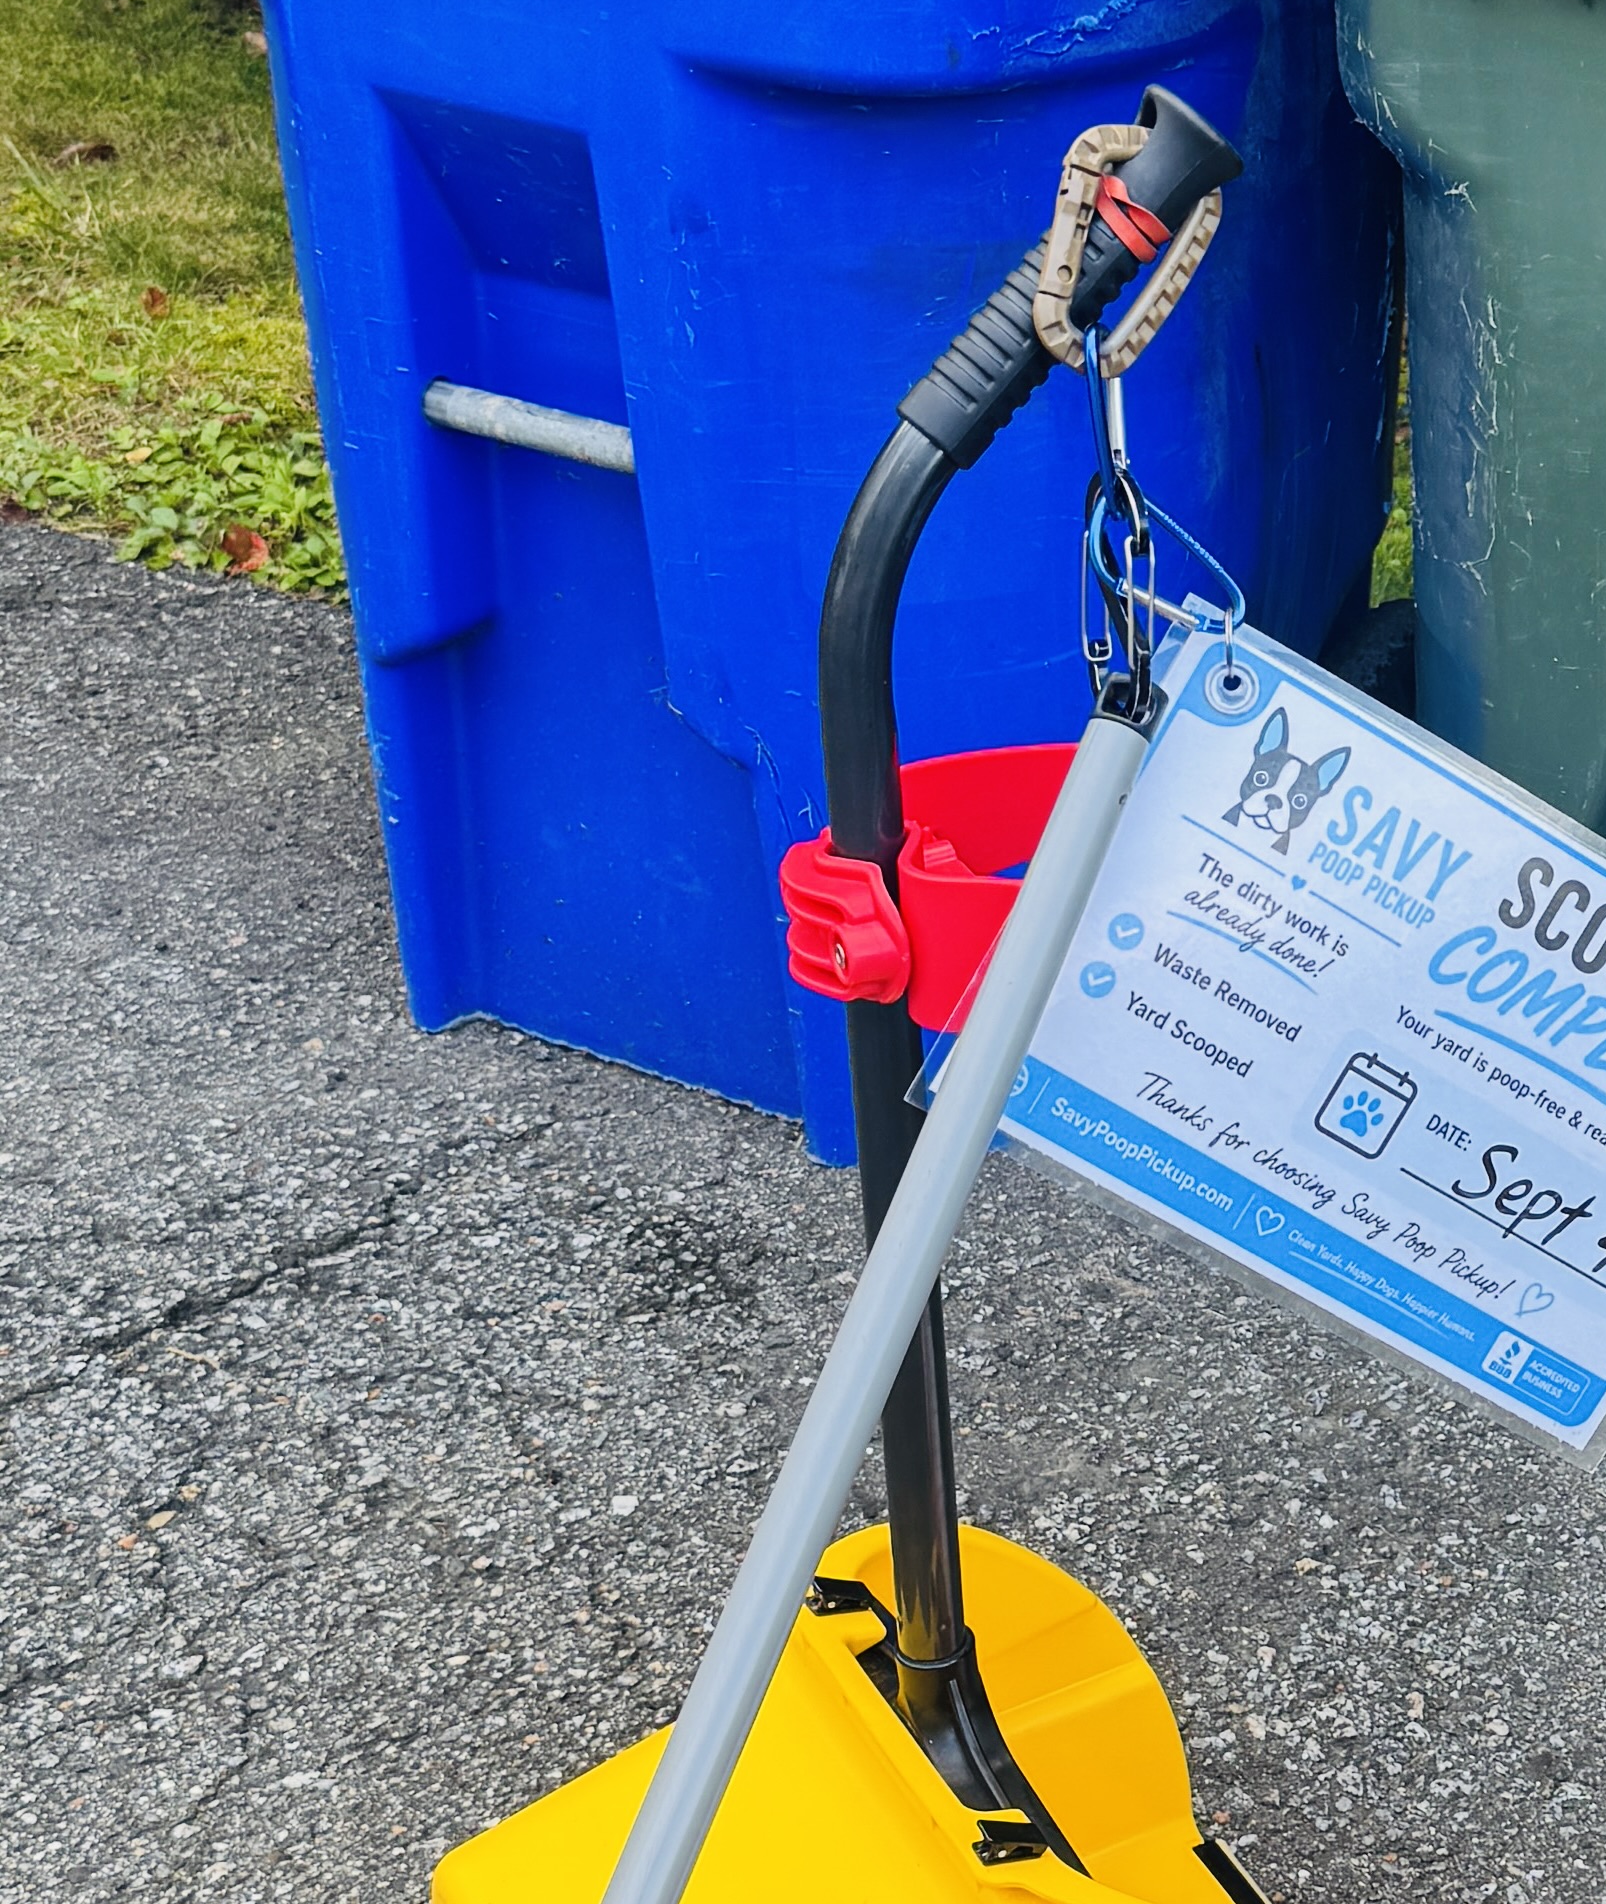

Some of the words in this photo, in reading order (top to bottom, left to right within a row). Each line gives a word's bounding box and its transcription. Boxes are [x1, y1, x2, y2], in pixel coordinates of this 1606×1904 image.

[1308, 841, 1365, 886] POOP
[1362, 874, 1436, 929] PICKUP
[1327, 786, 1473, 902] SAVY
[1184, 889, 1265, 952] already
[1268, 937, 1336, 978] done!
[1198, 853, 1234, 888] The
[1237, 881, 1283, 918] dirty
[1285, 910, 1331, 946] work
[1332, 934, 1350, 957] is
[1126, 990, 1171, 1030] Yard
[1170, 1019, 1254, 1078] Scooped
[1153, 943, 1212, 990] Waste
[1214, 980, 1303, 1042] Removed
[1396, 1005, 1434, 1041] Your
[1431, 1033, 1474, 1063] yard
[1472, 1052, 1489, 1073] is
[1488, 1066, 1567, 1120] poop-free
[1568, 1111, 1583, 1130] &
[1050, 1096, 1234, 1212] SavyPoopPickup.com
[1426, 1114, 1472, 1152] DATE:
[1136, 1071, 1214, 1132] Thanks
[1208, 1121, 1250, 1147] for
[1252, 1148, 1337, 1210] choosing
[1341, 1192, 1393, 1240] Savy
[1392, 1222, 1437, 1262] Poop
[1438, 1247, 1517, 1300] Pickup!
[1451, 1144, 1597, 1246] Sept
[1287, 1228, 1316, 1253] Clean
[1345, 1261, 1376, 1287] Happy
[1521, 1371, 1564, 1400] BUSINESS
[1528, 1359, 1581, 1394] ACCREDITED
